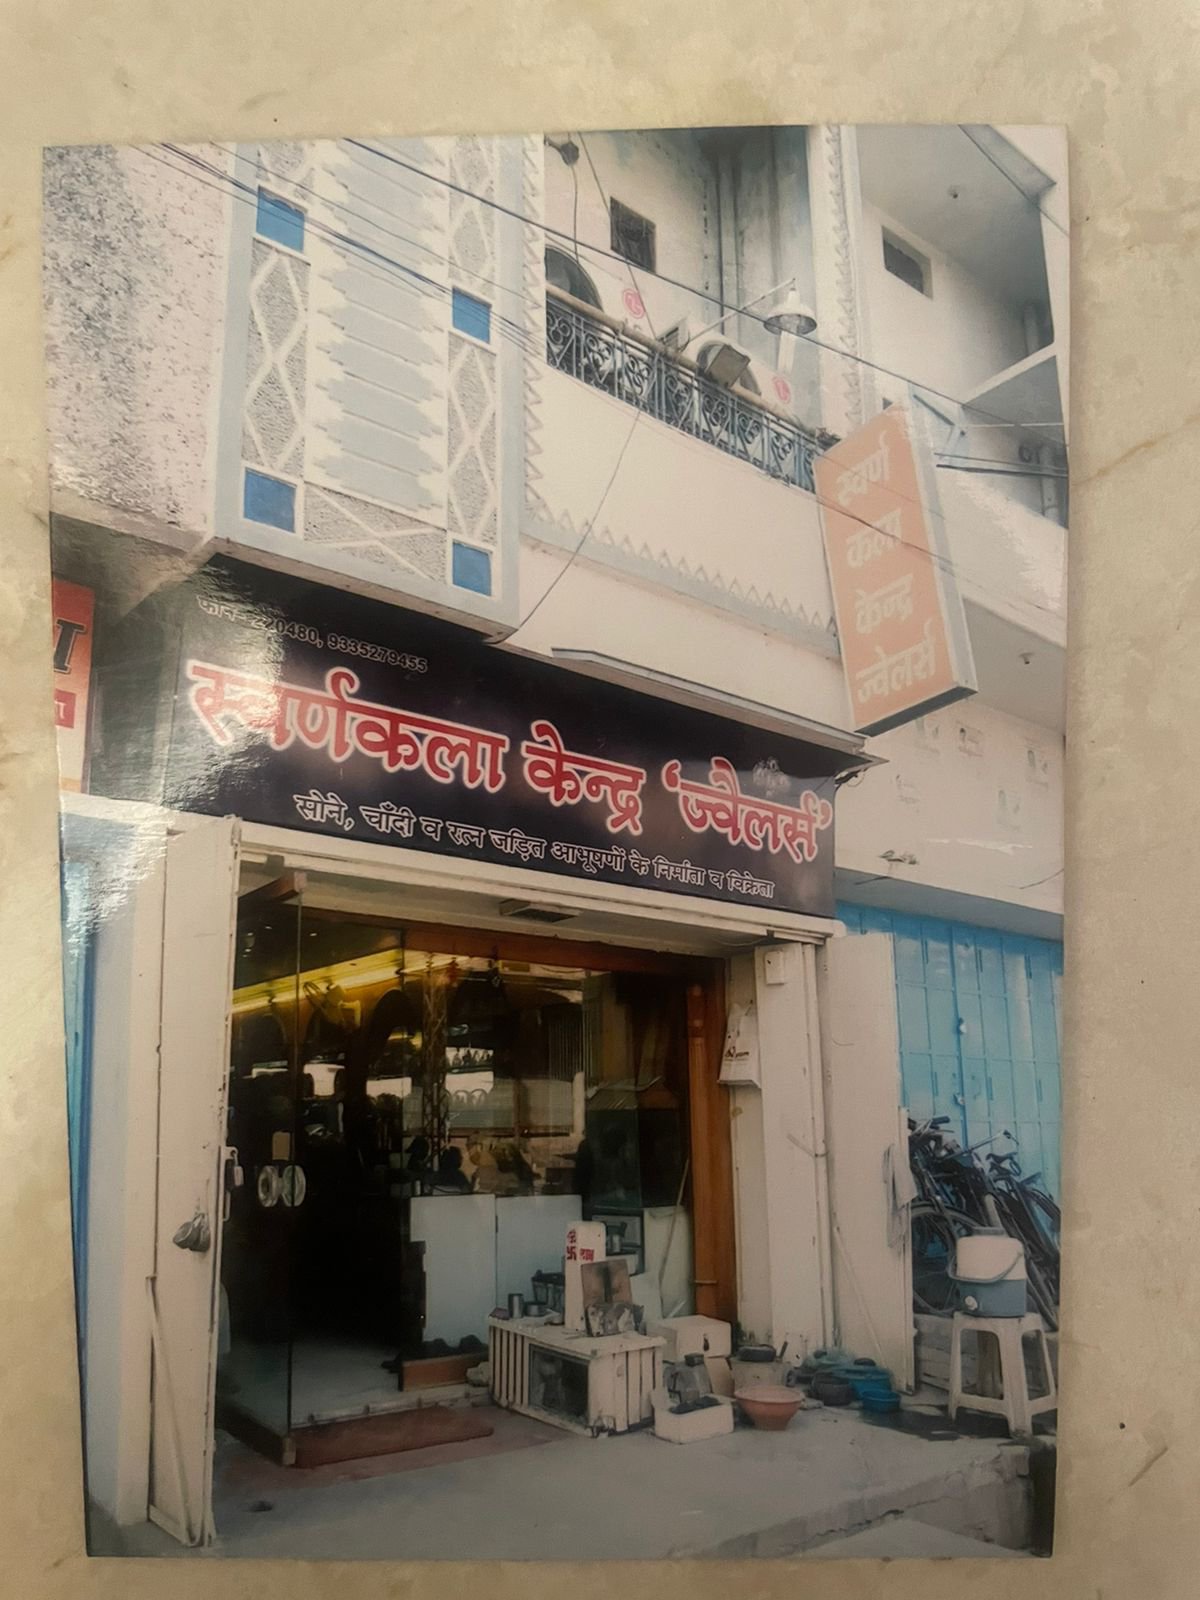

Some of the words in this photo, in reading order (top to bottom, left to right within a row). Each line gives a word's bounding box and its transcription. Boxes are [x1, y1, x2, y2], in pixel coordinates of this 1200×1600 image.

[327, 633, 428, 673] 9335279455
[521, 719, 646, 836] केन्द्र
[359, 801, 416, 838] चाँदी
[420, 816, 443, 842] व
[446, 820, 485, 848] रत्न
[488, 828, 547, 861] जड़ित
[551, 841, 625, 873] आभूषणों
[629, 849, 649, 876] के
[652, 855, 705, 886] निर्माता
[708, 870, 724, 889] व
[727, 869, 775, 899] विक्रेता
